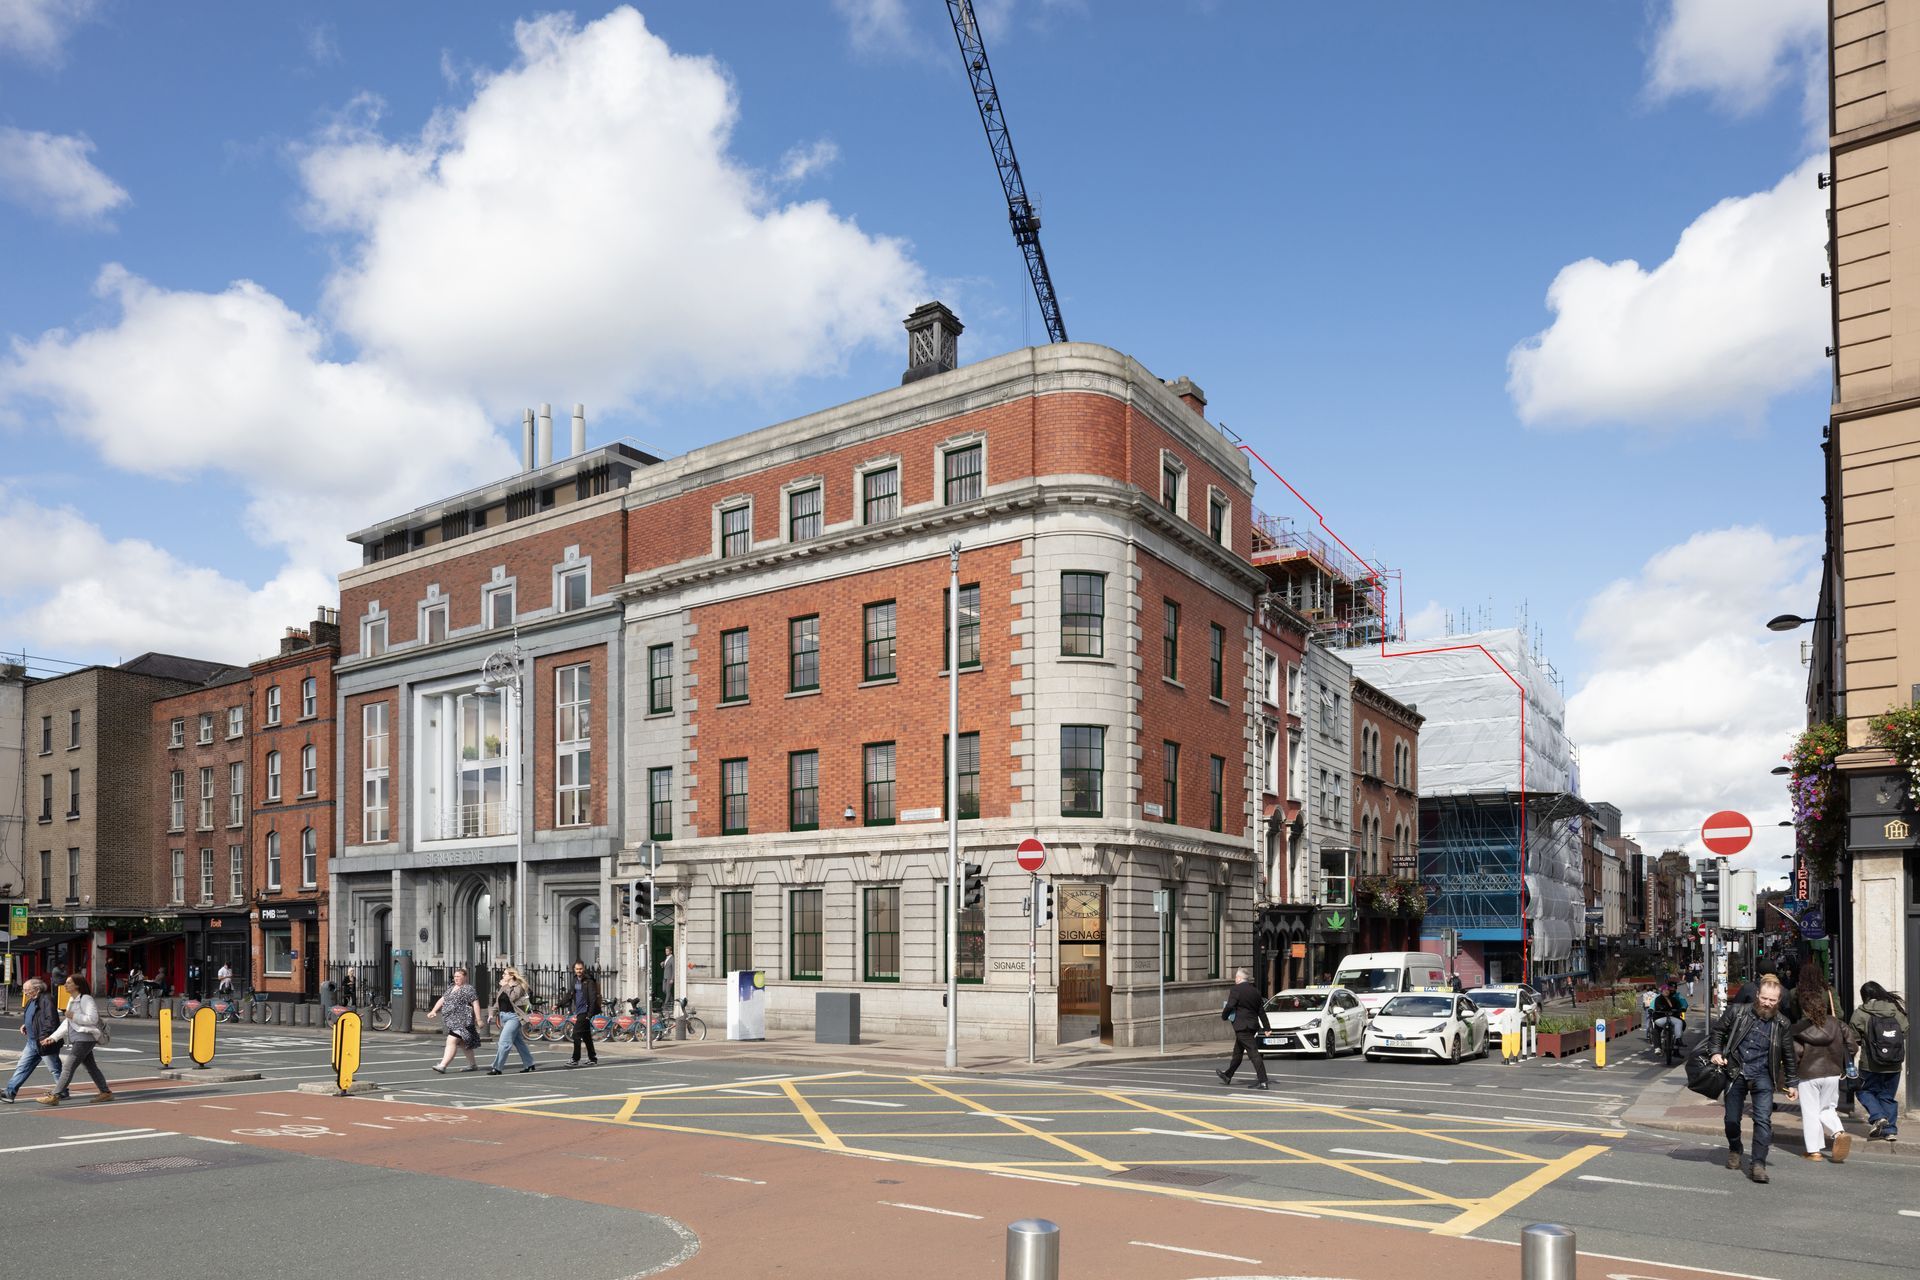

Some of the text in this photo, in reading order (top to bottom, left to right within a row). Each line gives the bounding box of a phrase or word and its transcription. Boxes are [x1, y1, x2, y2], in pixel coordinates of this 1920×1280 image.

[426, 852, 460, 865] SIGNAGE
[262, 910, 276, 919] FMB
[1059, 930, 1106, 940] SIGNAGE
[993, 961, 1026, 970] SIGNAGE
